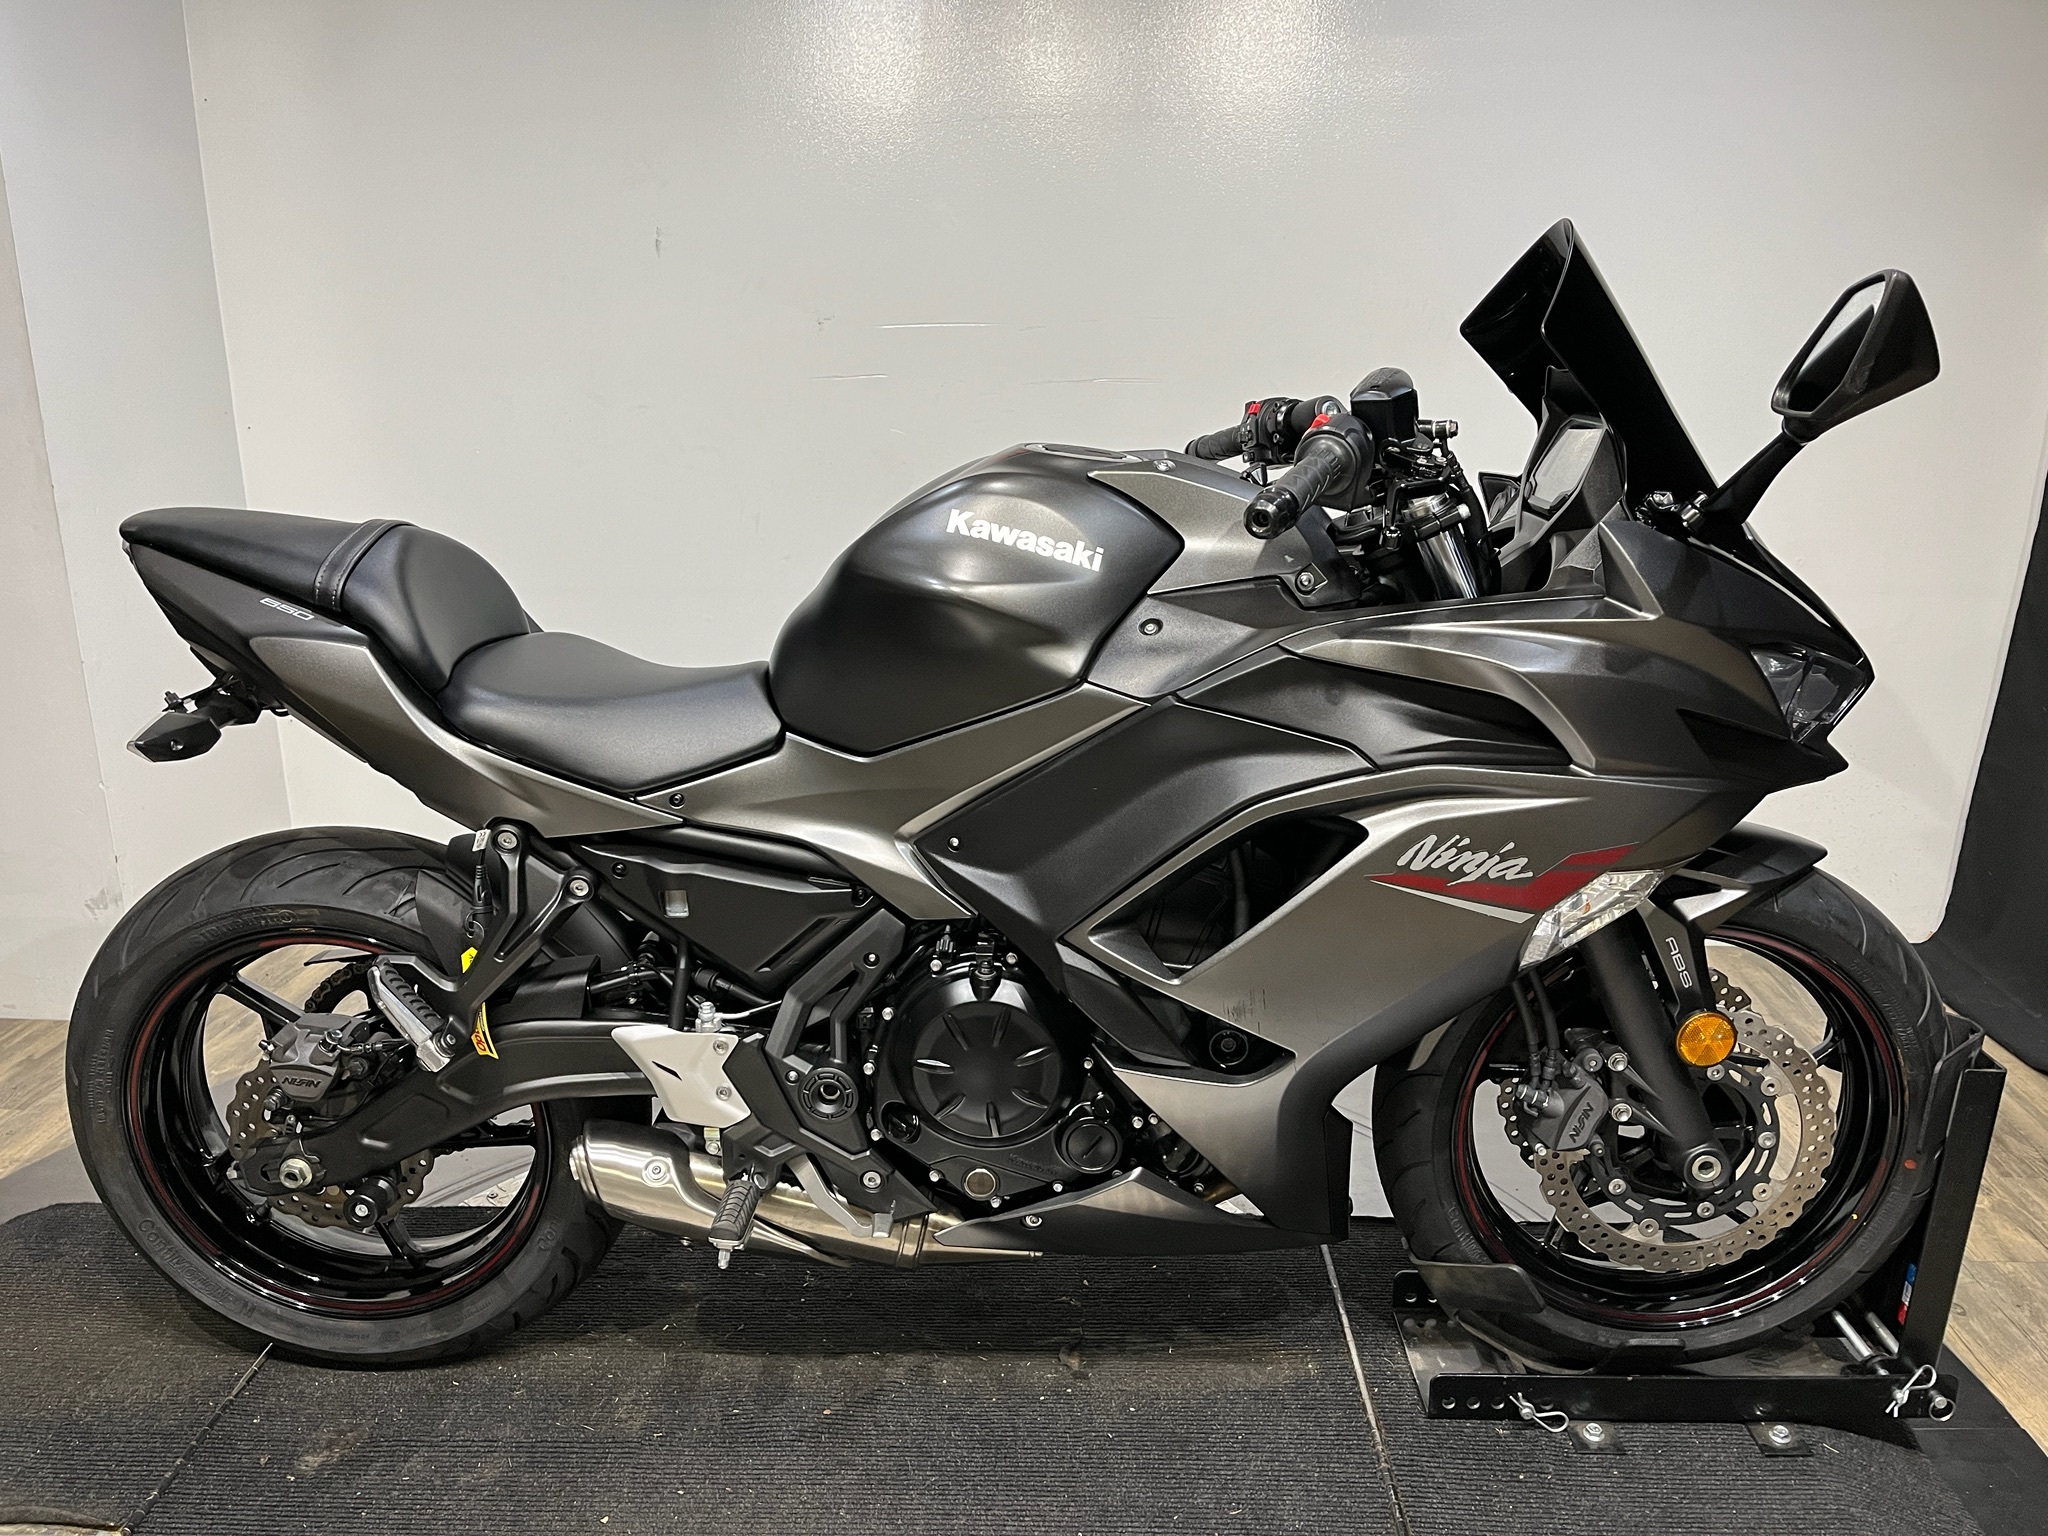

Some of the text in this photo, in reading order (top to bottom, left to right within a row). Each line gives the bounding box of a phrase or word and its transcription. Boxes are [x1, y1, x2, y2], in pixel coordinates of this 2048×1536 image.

[946, 508, 1104, 572] Kawasaki
[259, 597, 315, 621] 650
[1397, 834, 1534, 887] Ninja
[1665, 936, 1693, 988] ABS
